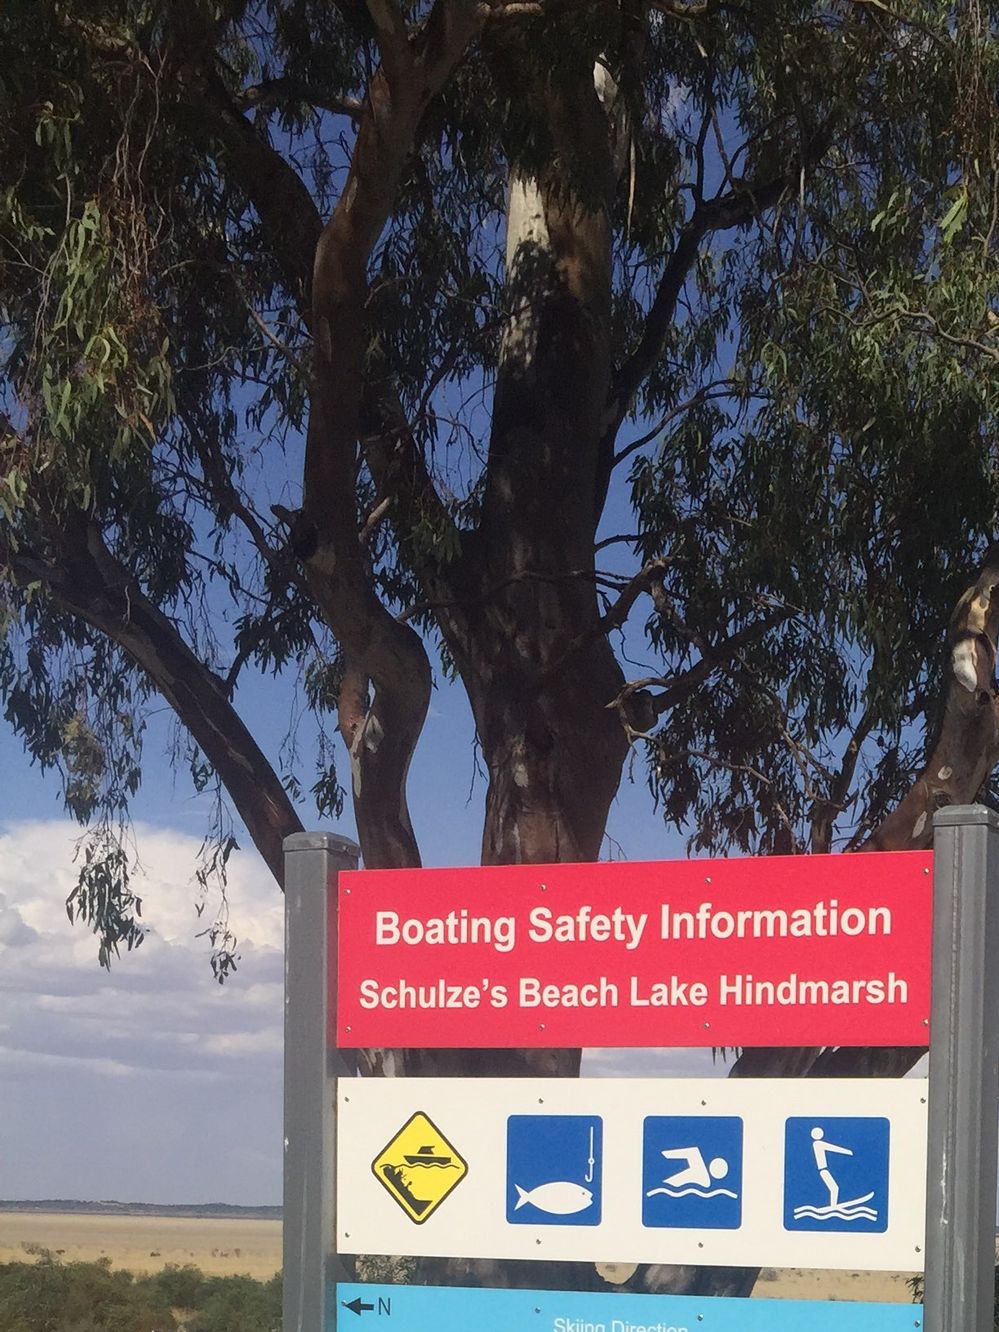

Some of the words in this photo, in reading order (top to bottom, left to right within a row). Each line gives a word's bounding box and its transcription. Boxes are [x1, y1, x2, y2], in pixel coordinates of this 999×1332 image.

[375, 910, 516, 951] Boating
[528, 905, 648, 949] Safety
[661, 900, 891, 940] Information
[359, 978, 508, 1009] Schulze’s
[519, 977, 619, 1008] Beach
[630, 975, 708, 1007] Lake
[719, 972, 908, 1006] Hindmarsh
[378, 1298, 391, 1316] N
